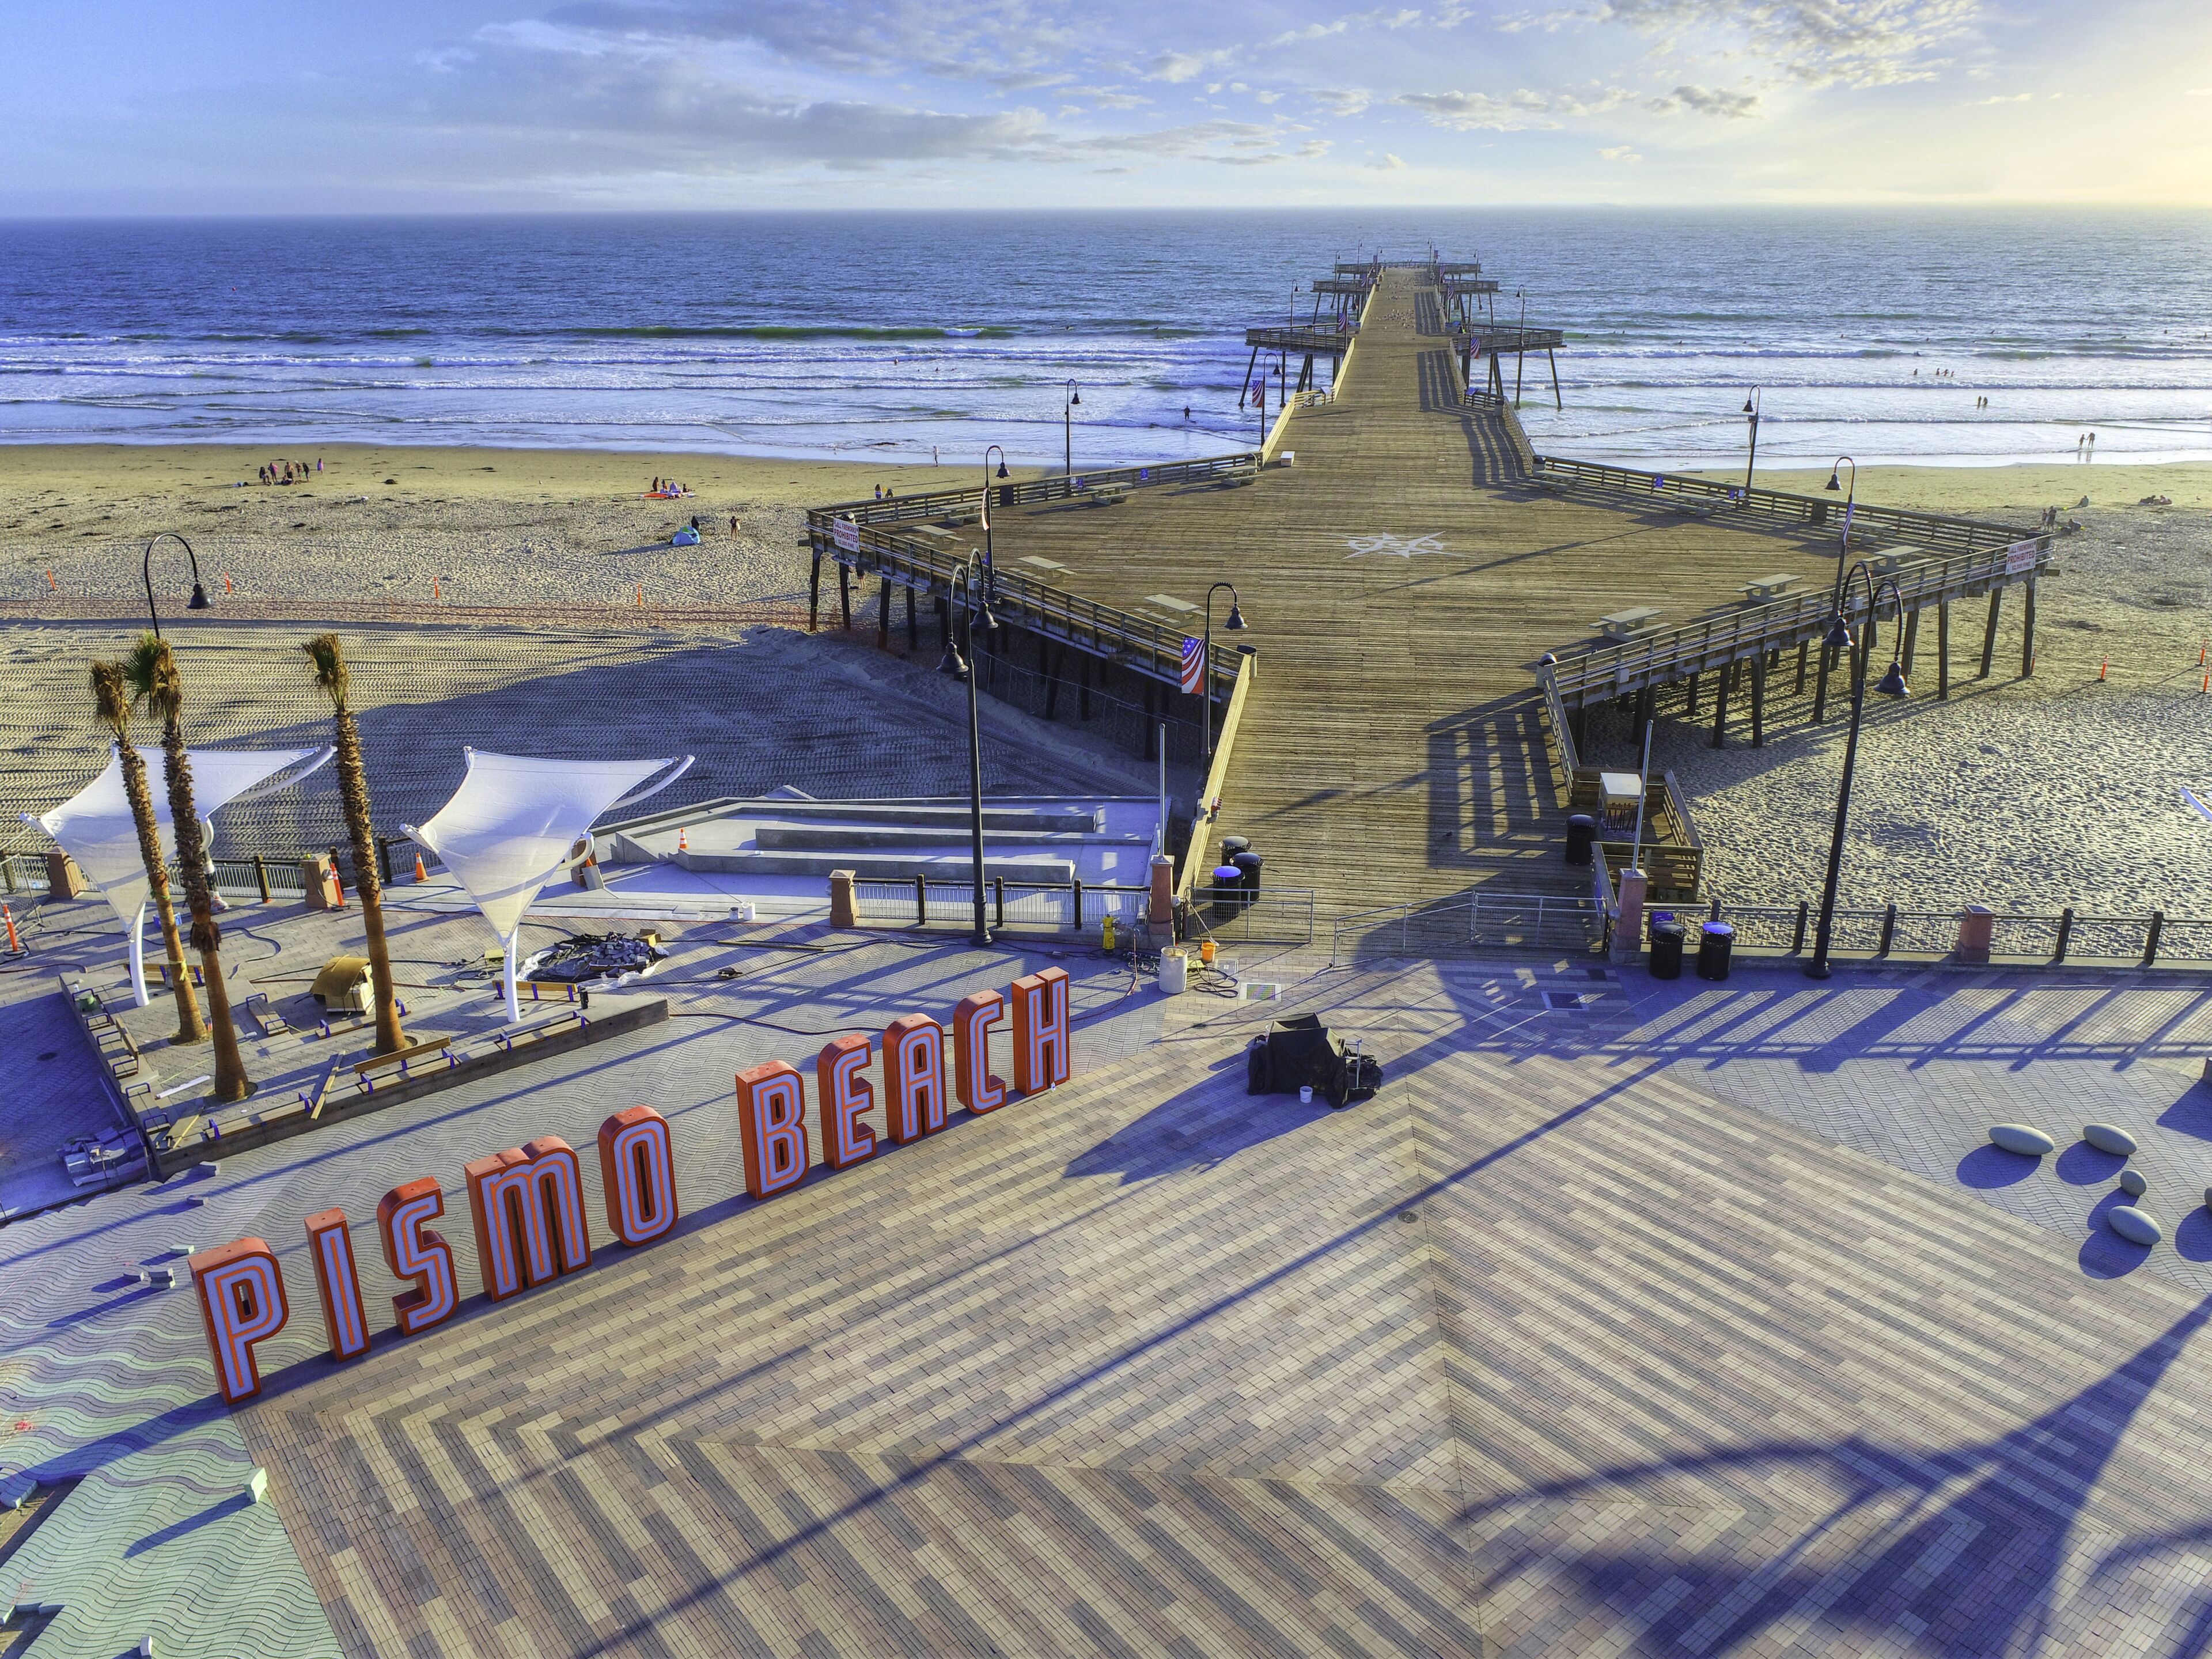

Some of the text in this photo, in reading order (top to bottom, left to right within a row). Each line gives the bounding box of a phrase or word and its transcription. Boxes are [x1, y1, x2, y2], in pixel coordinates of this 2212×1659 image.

[842, 524, 857, 533] FIREWORKS
[834, 529, 858, 543] PROHIBITED
[2008, 551, 2035, 563] PROHIBITED
[189, 967, 1070, 1404] PISMO BEACH
